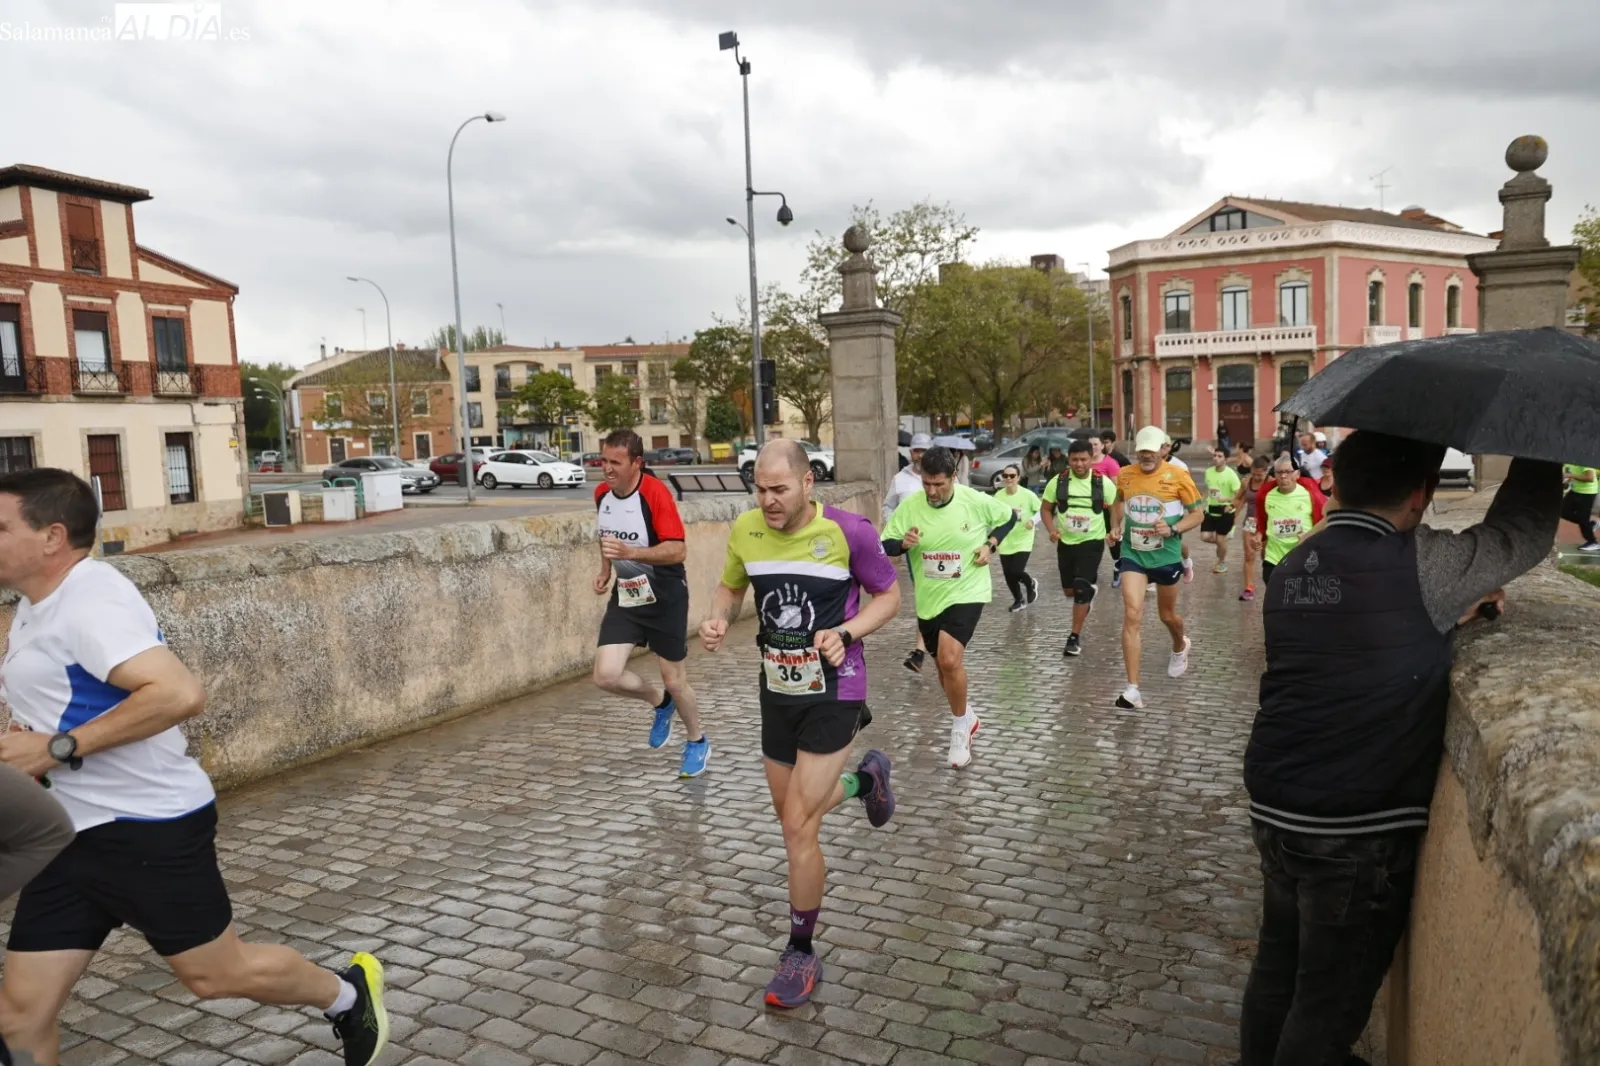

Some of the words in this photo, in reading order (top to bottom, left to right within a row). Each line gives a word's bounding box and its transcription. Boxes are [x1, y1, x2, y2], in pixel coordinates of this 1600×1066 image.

[1279, 525, 1296, 533] 257
[1143, 536, 1150, 544] 2
[937, 561, 945, 571] 6
[626, 587, 640, 598] 89
[1284, 576, 1341, 604] PLNS
[778, 665, 802, 682] 36
